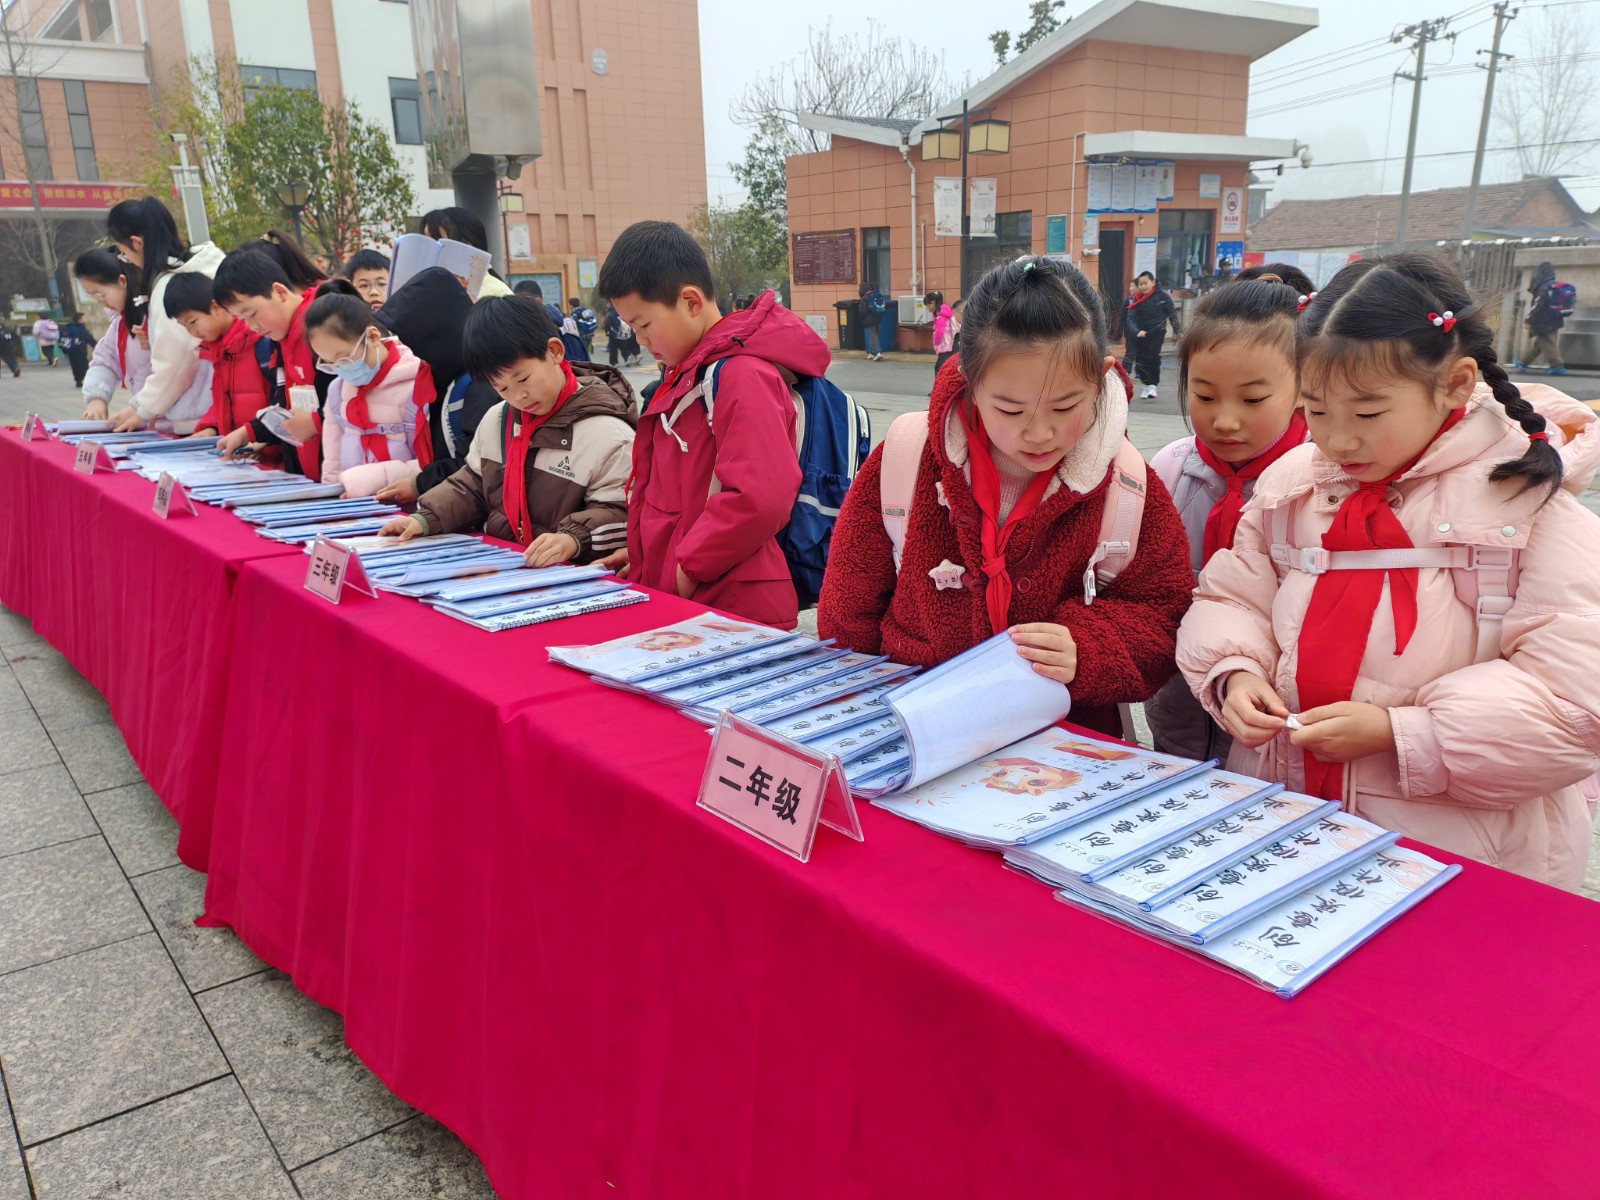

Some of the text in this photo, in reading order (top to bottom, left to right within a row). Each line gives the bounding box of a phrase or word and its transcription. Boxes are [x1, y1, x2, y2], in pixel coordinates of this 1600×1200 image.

[313, 556, 340, 586] 三年级
[718, 754, 803, 826] 二年级
[1016, 761, 1172, 824] 创意寒假作业
[1079, 778, 1237, 848] 创意寒假作业
[1132, 796, 1292, 876] 创意寒假作业
[1183, 817, 1349, 903] 创意寒假作业
[1258, 851, 1408, 949] 创意寒假作业
